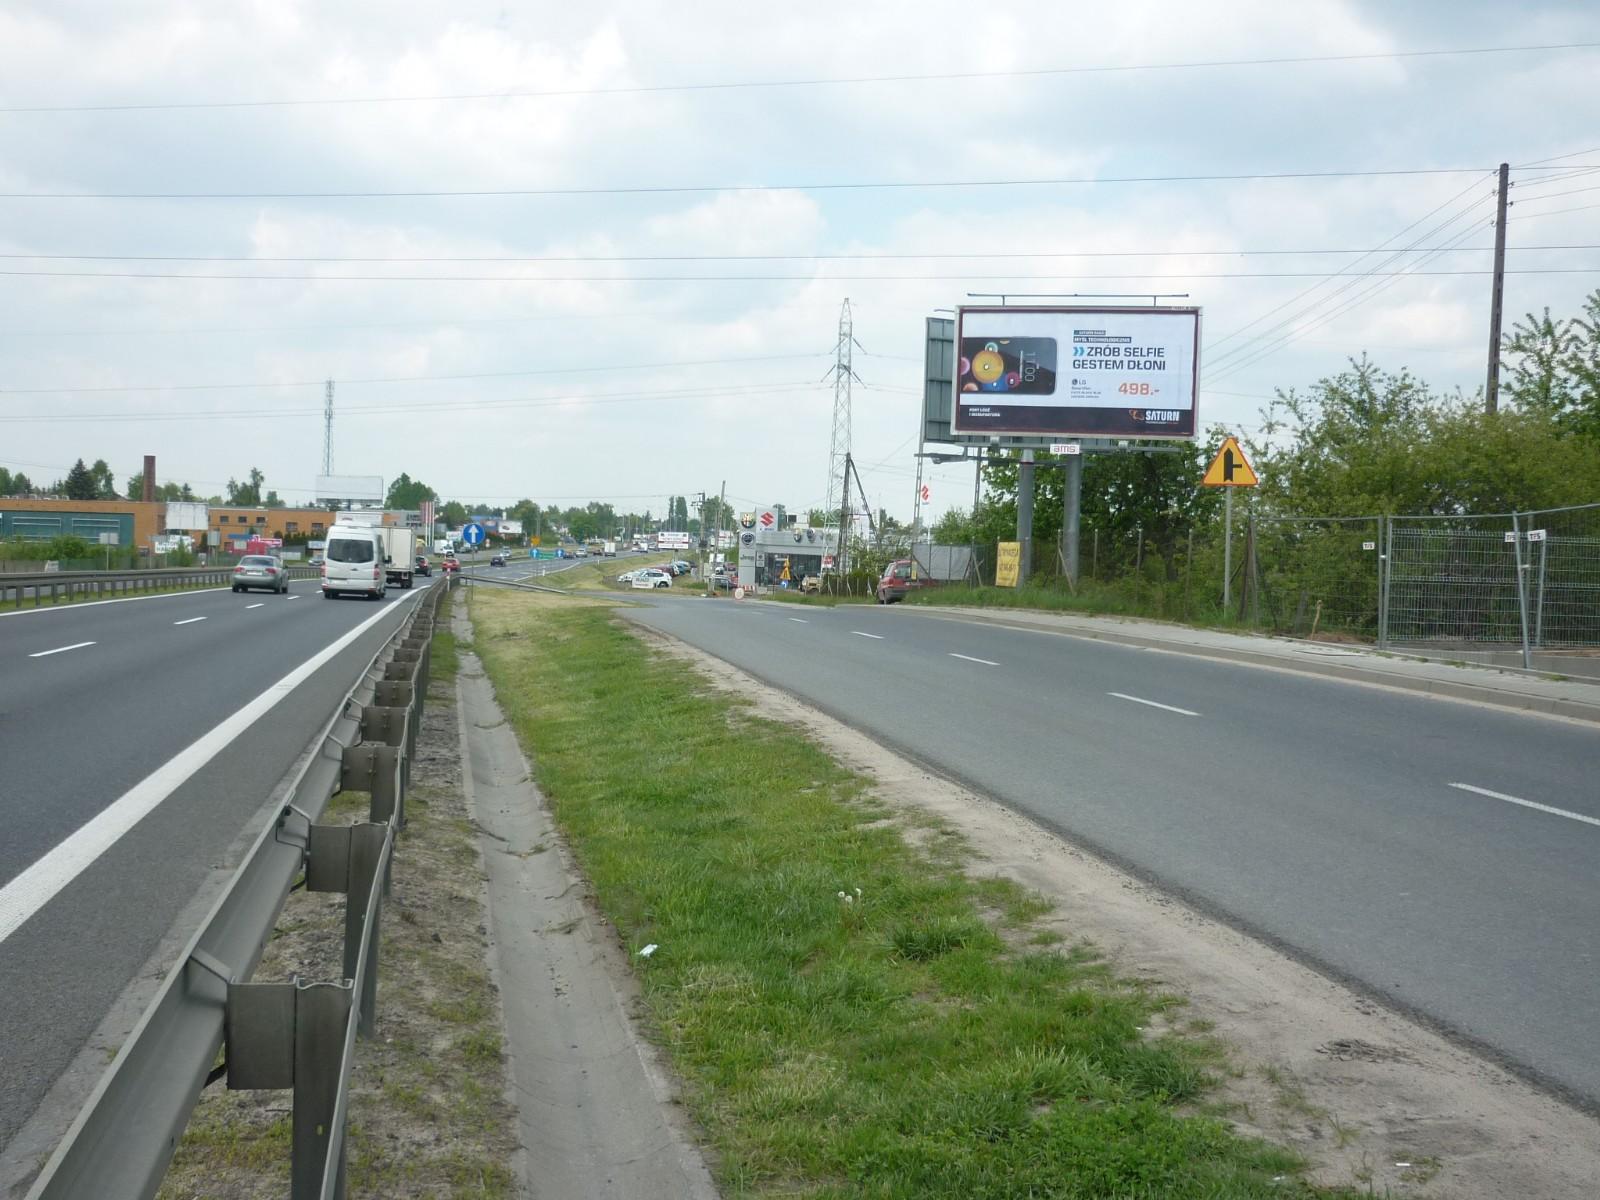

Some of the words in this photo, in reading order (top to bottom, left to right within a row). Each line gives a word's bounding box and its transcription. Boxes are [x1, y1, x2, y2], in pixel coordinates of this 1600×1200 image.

[1087, 345, 1120, 357] ZRÓB
[1124, 347, 1164, 358] SELFIE
[1073, 359, 1123, 369] GESTEM
[1127, 360, 1165, 371] DŁONI
[1118, 382, 1160, 396] 498.-
[1145, 410, 1180, 421] SATURN
[1053, 445, 1076, 453] ams
